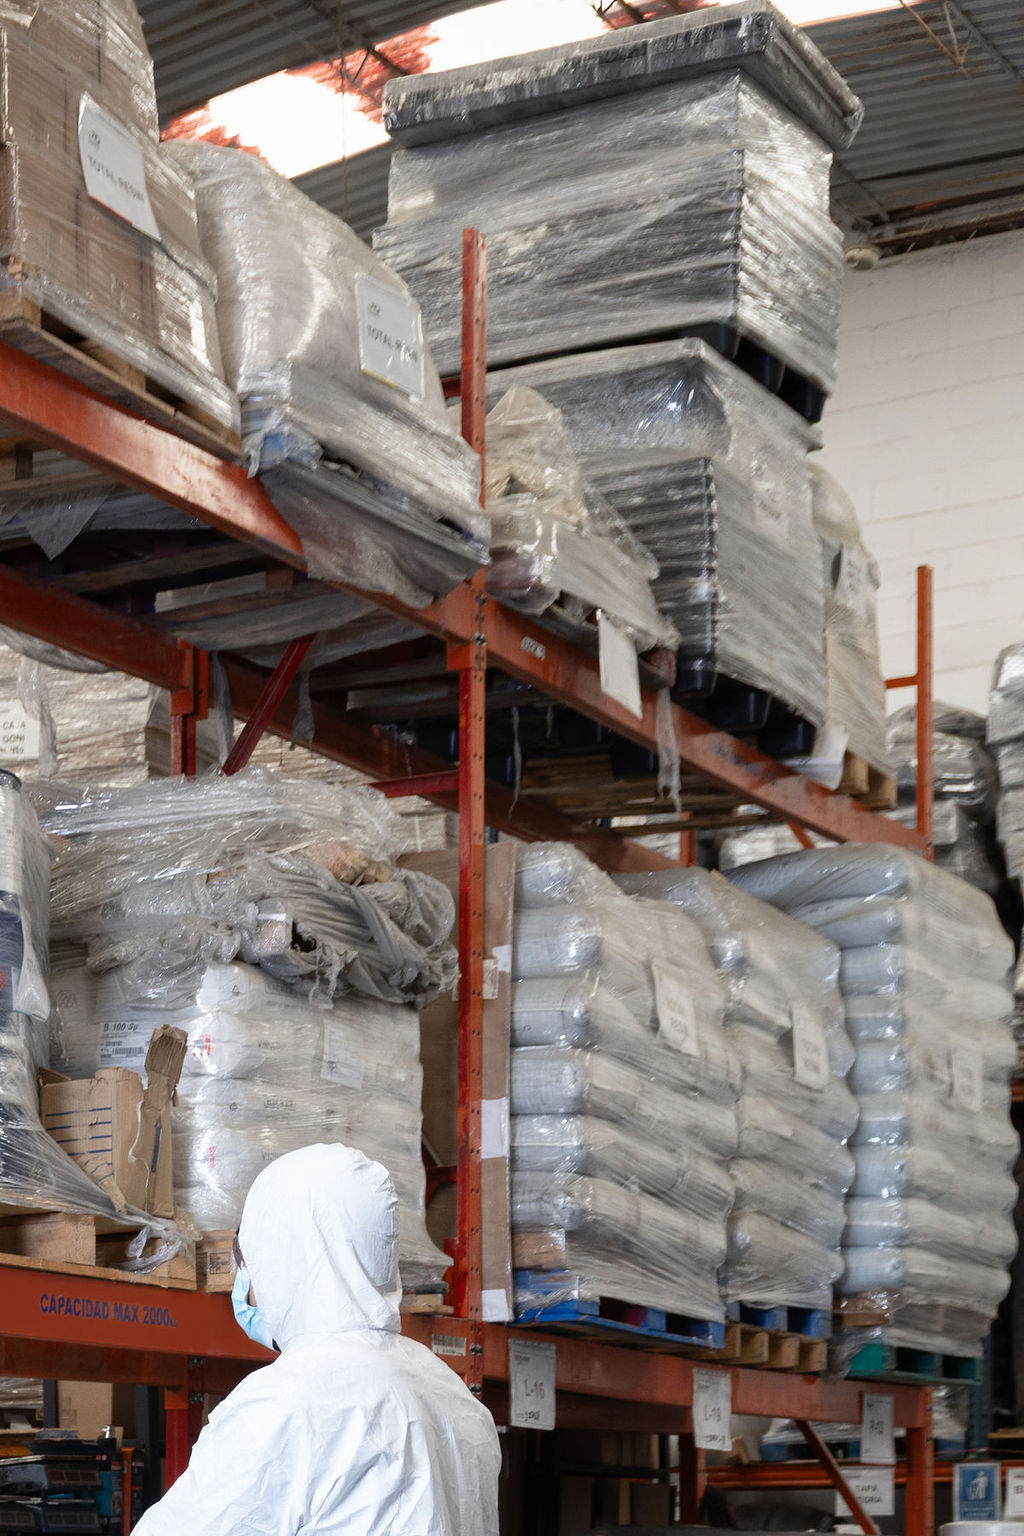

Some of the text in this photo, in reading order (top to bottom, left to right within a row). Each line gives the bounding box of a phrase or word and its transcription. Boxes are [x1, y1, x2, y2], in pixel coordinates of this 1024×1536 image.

[112, 1022, 127, 1032] 100
[40, 1293, 110, 1319] CAPACIDAD
[113, 1302, 140, 1323] MAX
